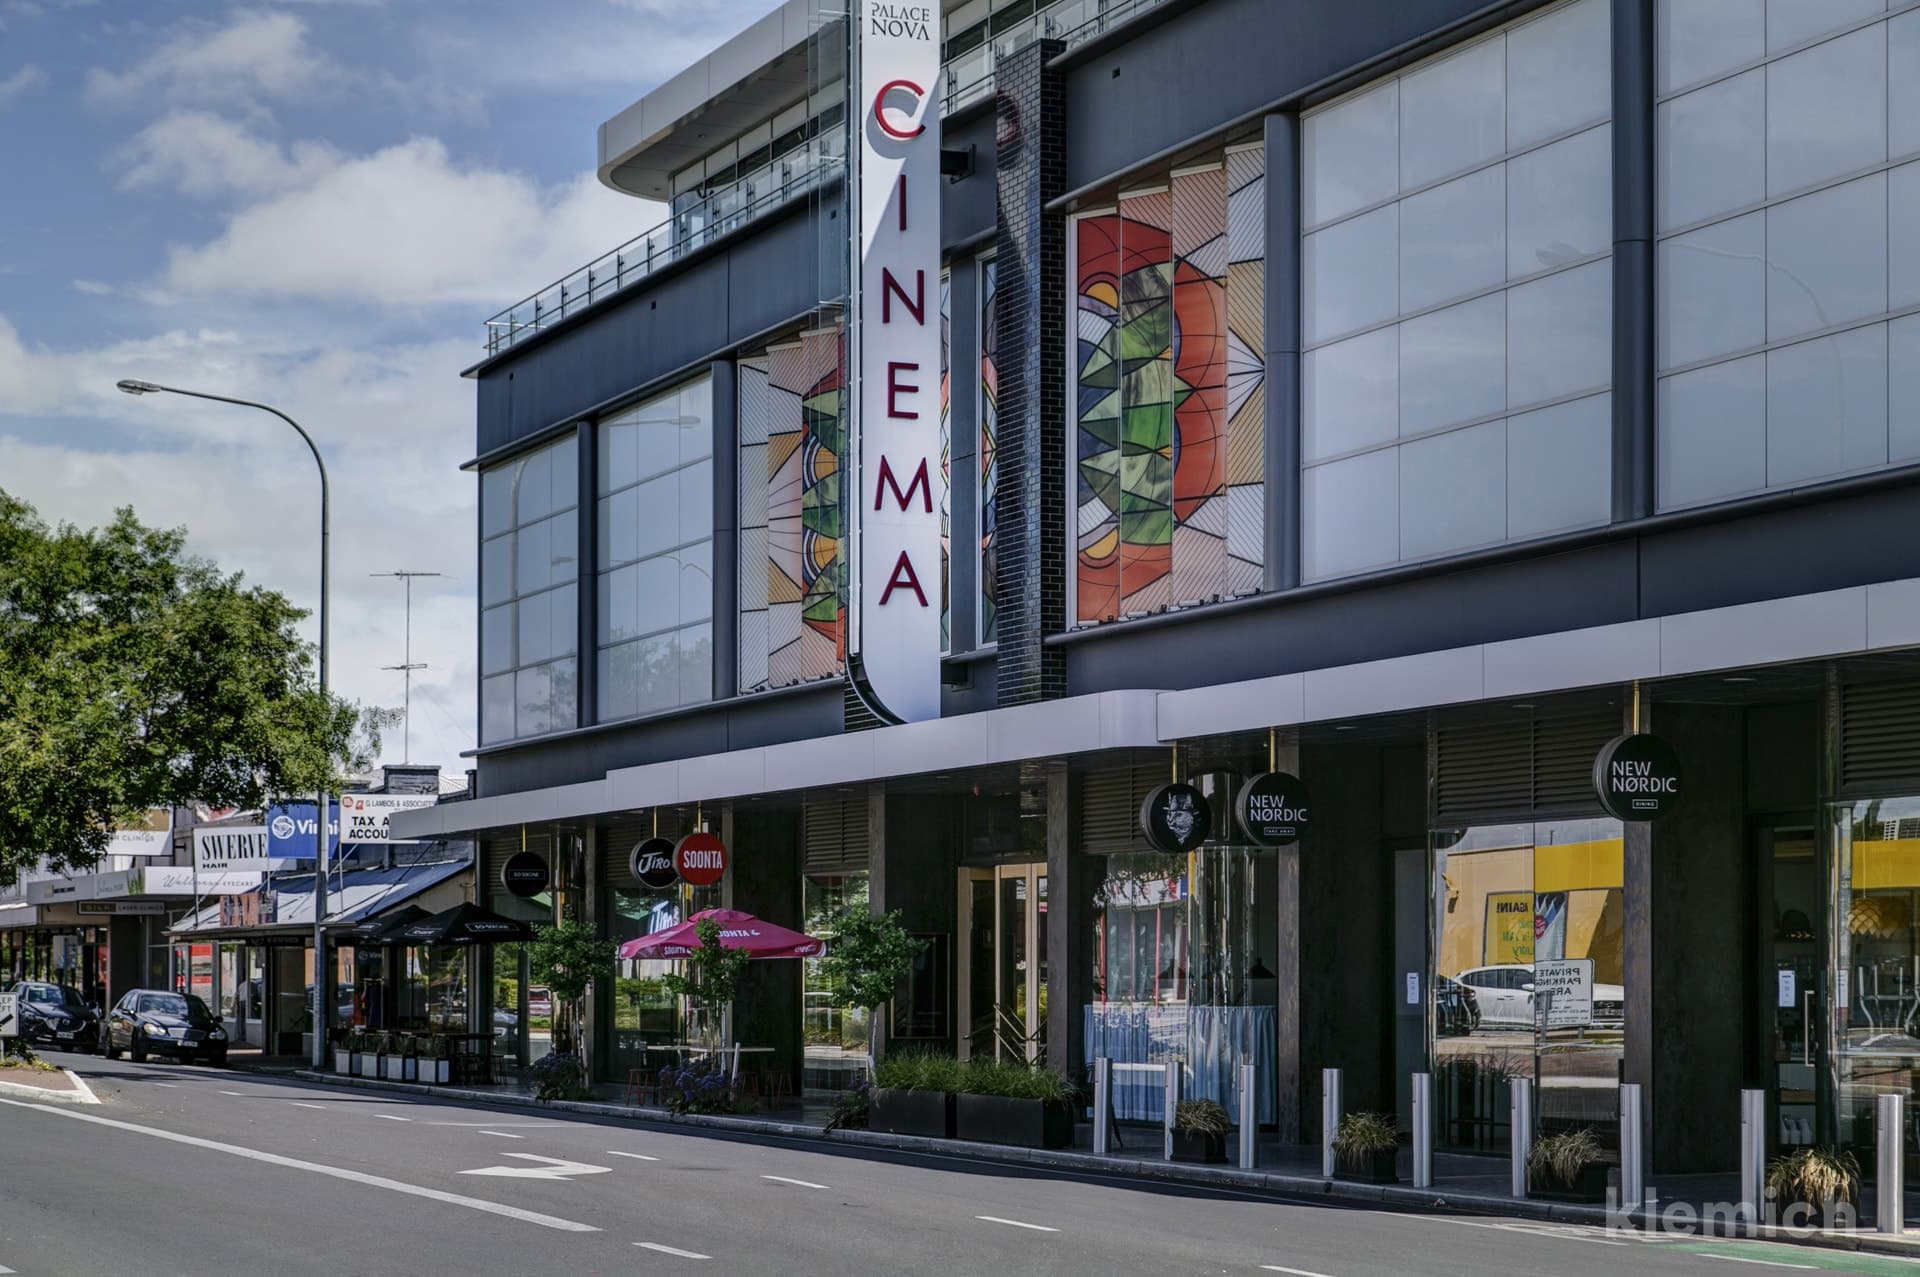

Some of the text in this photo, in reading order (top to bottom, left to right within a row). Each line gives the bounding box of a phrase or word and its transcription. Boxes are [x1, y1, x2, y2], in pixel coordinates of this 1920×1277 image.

[871, 2, 930, 22] PALACE
[871, 19, 930, 41] NOVA
[874, 79, 933, 607] CINEMA
[1612, 761, 1651, 776] NEW
[1612, 777, 1677, 792] NØRDIC
[371, 800, 395, 808] LAMBOS
[1250, 795, 1284, 808] NEW
[352, 816, 375, 826] TAX
[1250, 808, 1308, 821] NØRDIC
[202, 833, 268, 861] SWERVE
[683, 850, 723, 869] SOONTA
